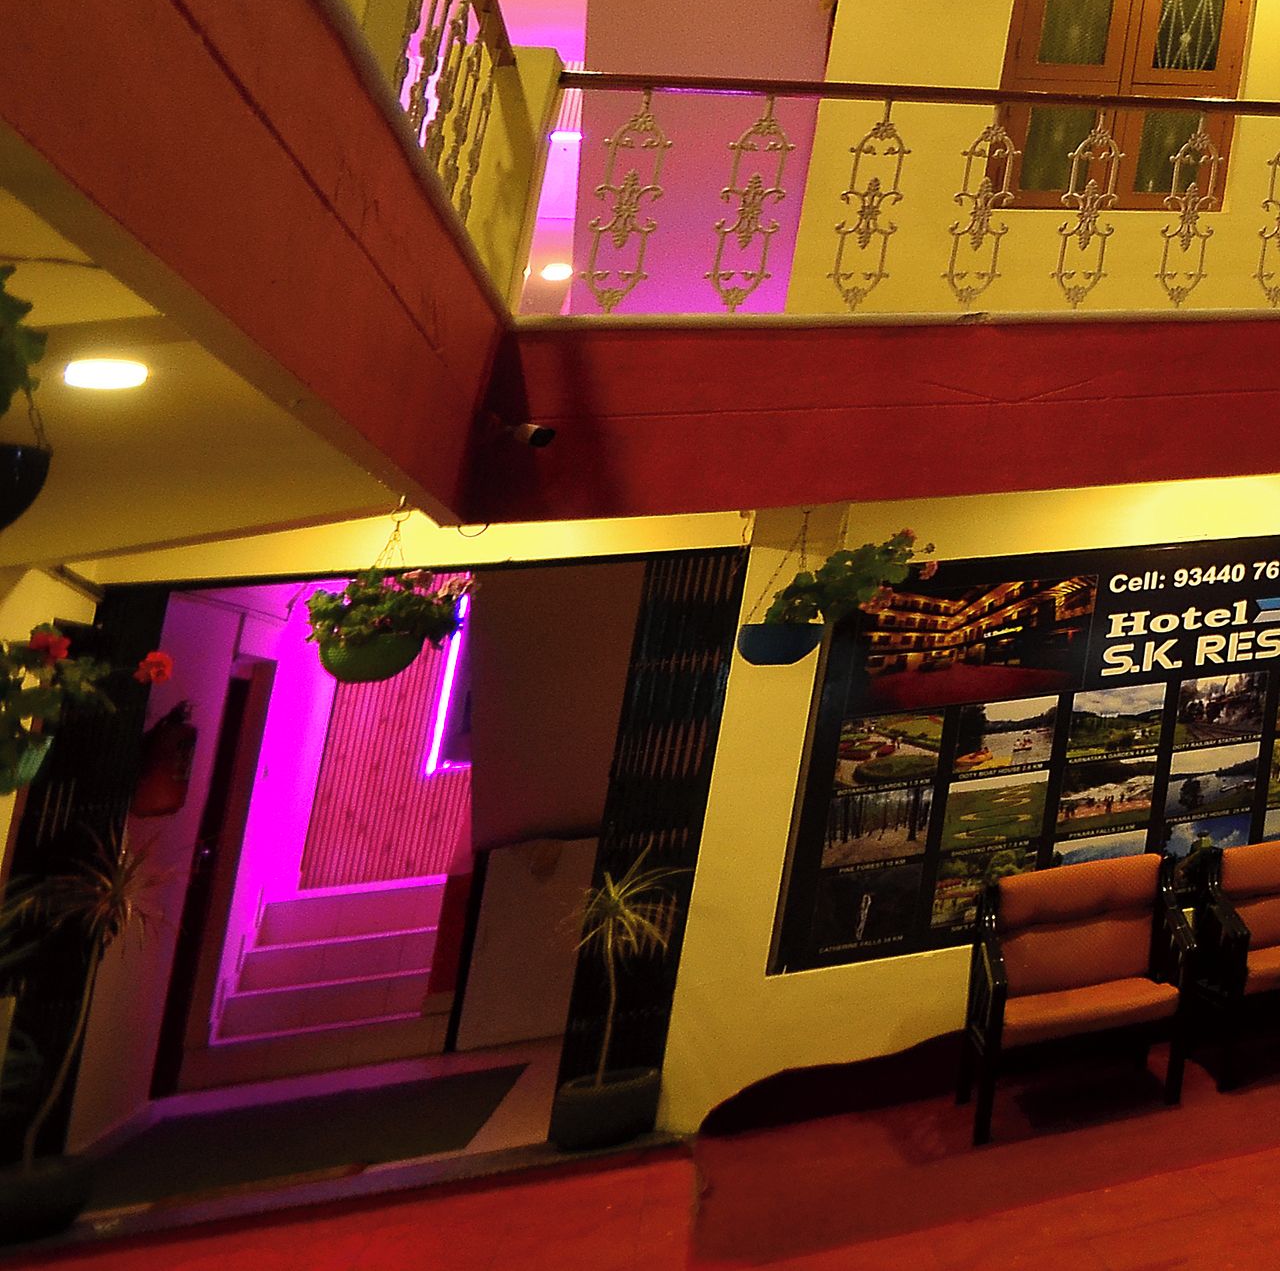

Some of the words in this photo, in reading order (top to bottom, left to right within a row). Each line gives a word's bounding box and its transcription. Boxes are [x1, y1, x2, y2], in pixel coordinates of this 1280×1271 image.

[1109, 573, 1166, 593] Cell:
[1173, 563, 1246, 588] 93440
[1106, 600, 1249, 639] Hotel
[1217, 736, 1243, 746] STATION
[1068, 753, 1107, 764] KARNATAKA
[1108, 750, 1134, 759] GARDEN
[958, 771, 978, 780] OOTY
[978, 769, 998, 777] BOAT
[998, 765, 1022, 775] HOUSE
[837, 785, 877, 796] BOTANICAL
[878, 781, 908, 791] GARDEN
[920, 778, 931, 786] KM
[1208, 809, 1231, 819] HOUSE
[1094, 826, 1116, 835] FALLS
[951, 845, 986, 857] SHOOTING
[987, 843, 1006, 852] POINT
[1017, 840, 1030, 848] KM
[856, 861, 885, 872] FOREST
[894, 858, 906, 866] KM
[818, 942, 859, 954] CATHERINE
[860, 938, 881, 947] FALLS
